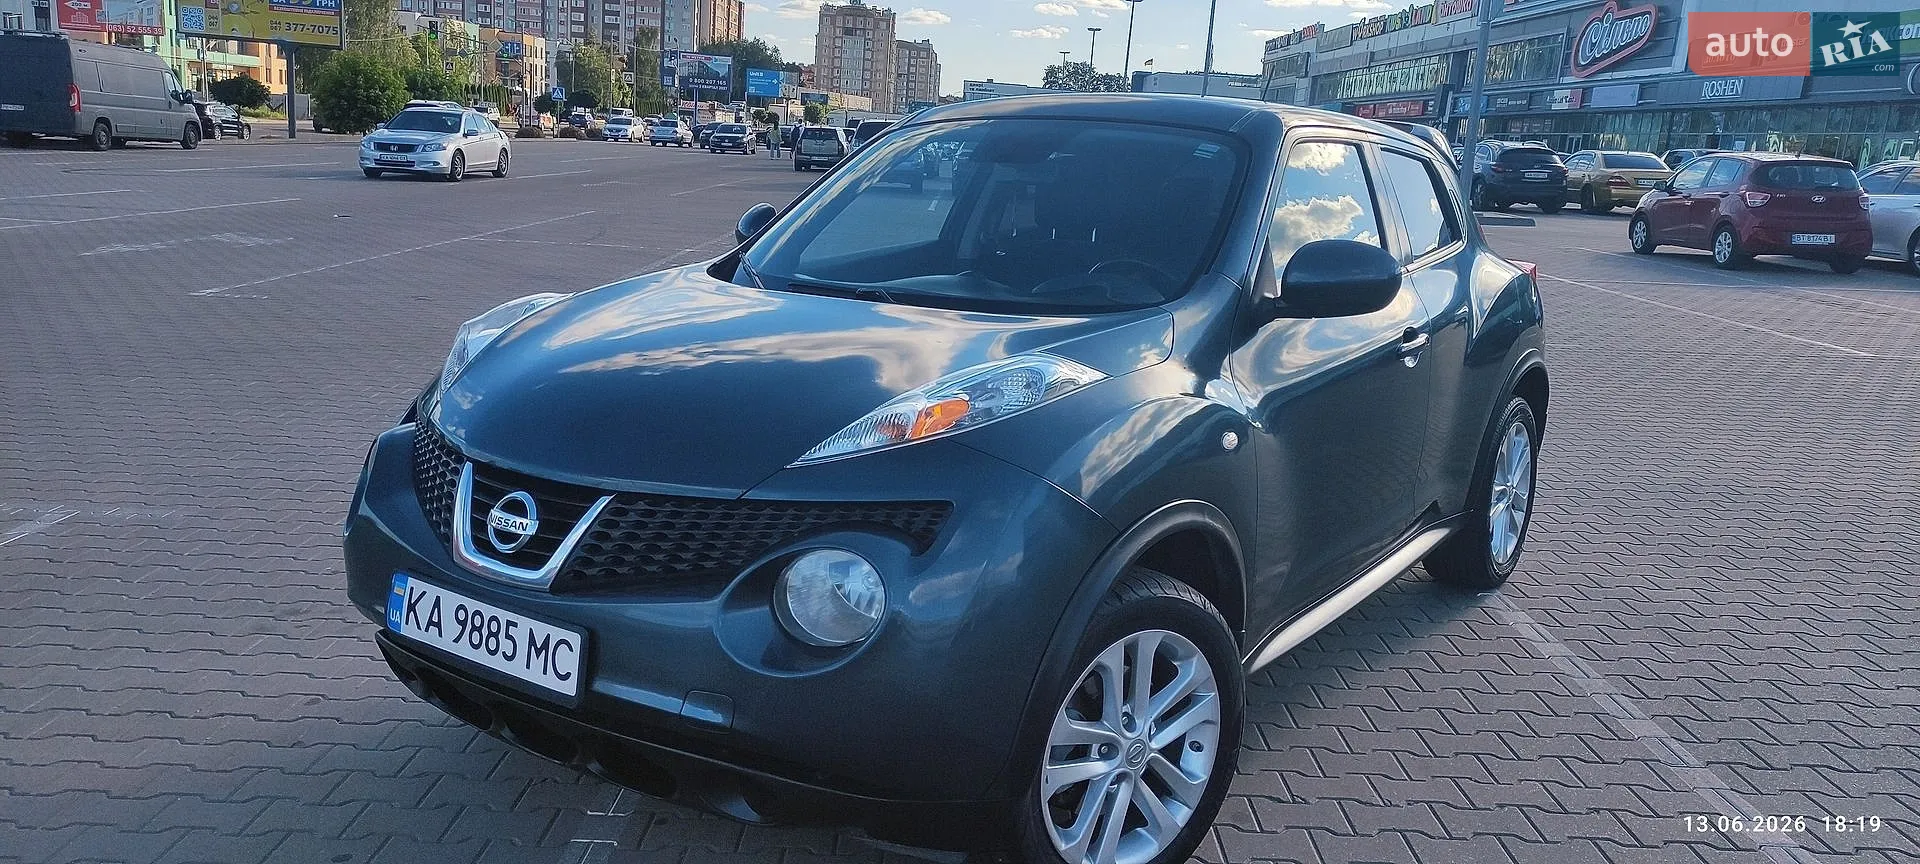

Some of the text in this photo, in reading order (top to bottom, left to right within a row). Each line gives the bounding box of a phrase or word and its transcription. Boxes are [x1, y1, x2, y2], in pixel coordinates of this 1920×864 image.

[126, 25, 136, 33] 52
[138, 26, 152, 34] 555
[285, 22, 339, 35] 377-7075
[1702, 79, 1743, 99] ROSHEN
[488, 513, 529, 532] NISSAN
[390, 608, 400, 624] UA
[405, 586, 574, 682] KA 9885 MC
